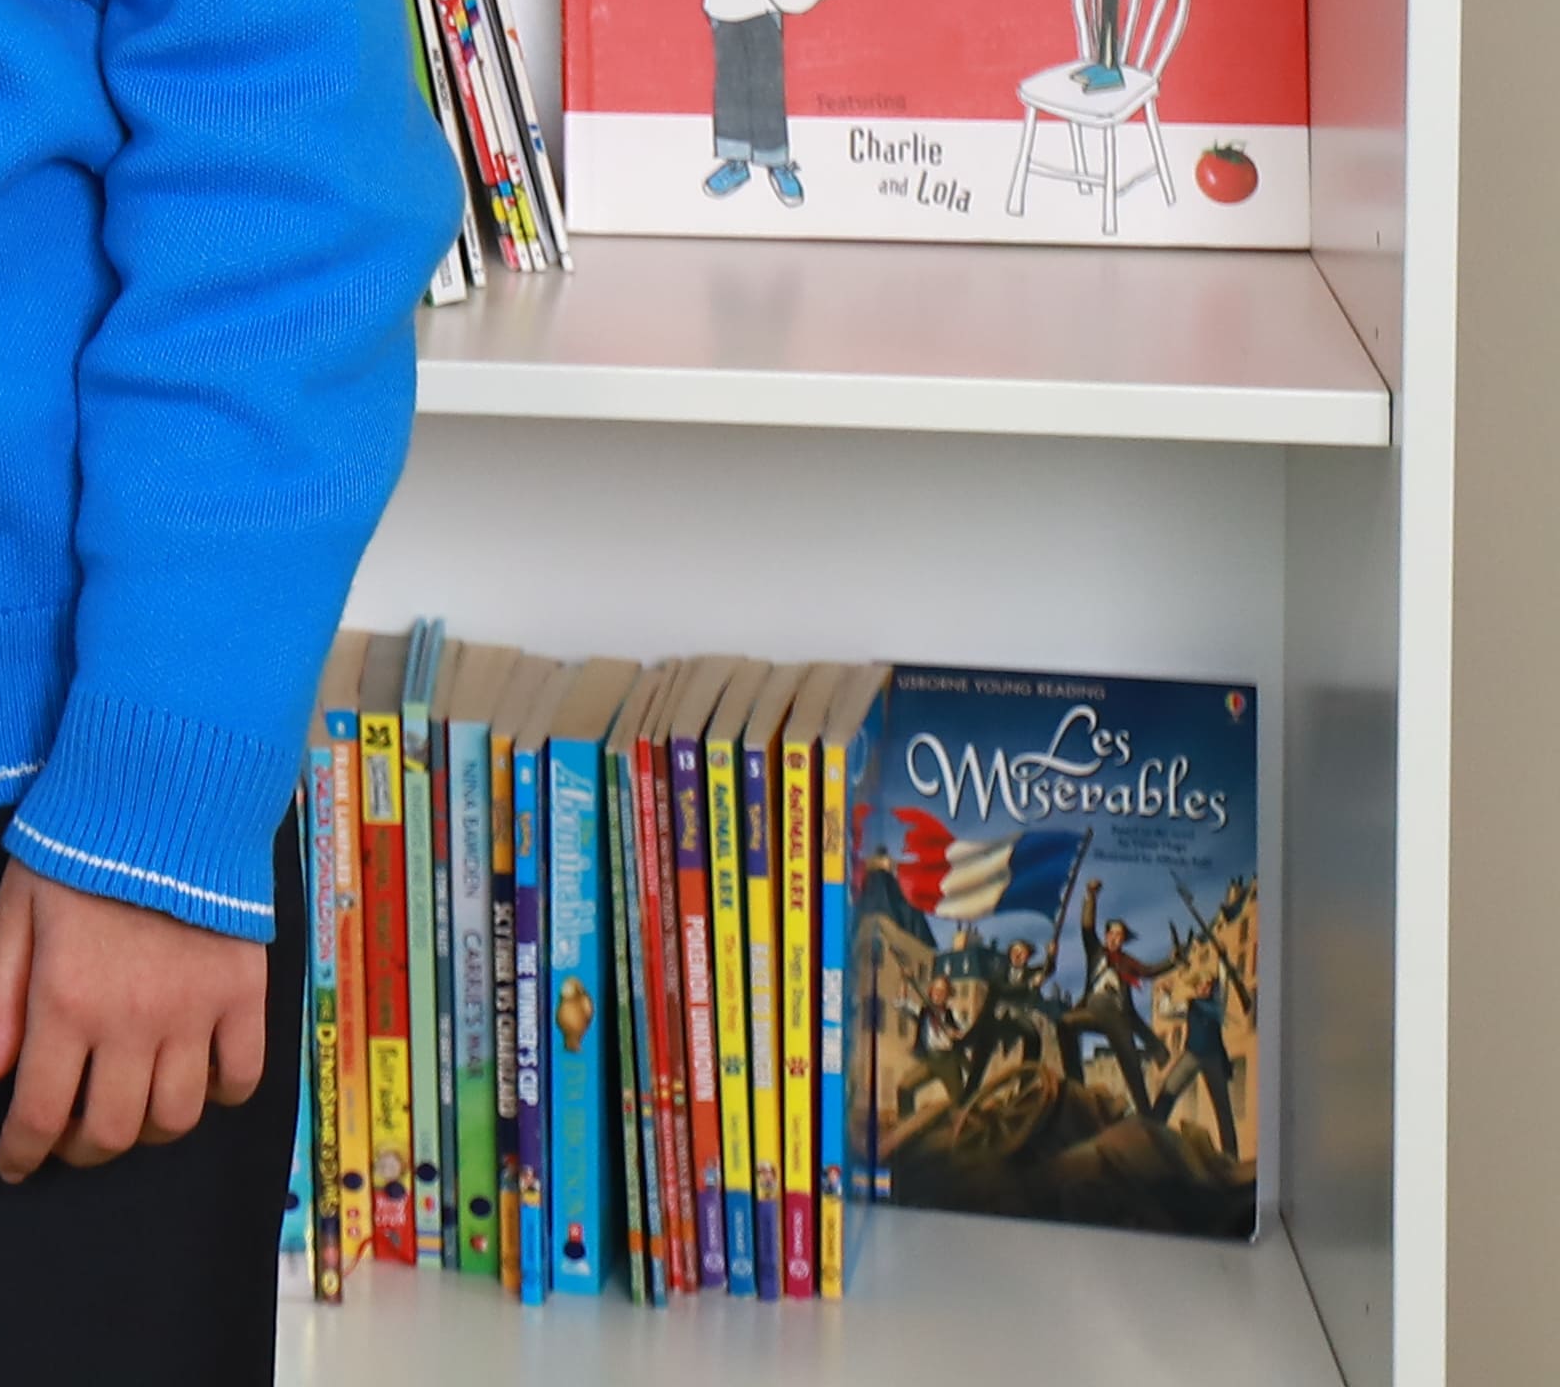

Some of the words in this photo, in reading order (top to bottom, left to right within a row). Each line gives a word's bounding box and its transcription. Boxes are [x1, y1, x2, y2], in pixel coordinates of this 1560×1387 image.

[849, 127, 942, 165] Charlie
[879, 177, 908, 196] and
[917, 170, 971, 213] Lola
[897, 674, 968, 694] USBORNE
[975, 681, 1032, 697] YOUNG
[1037, 683, 1106, 701] READING
[1011, 704, 1132, 777] Les
